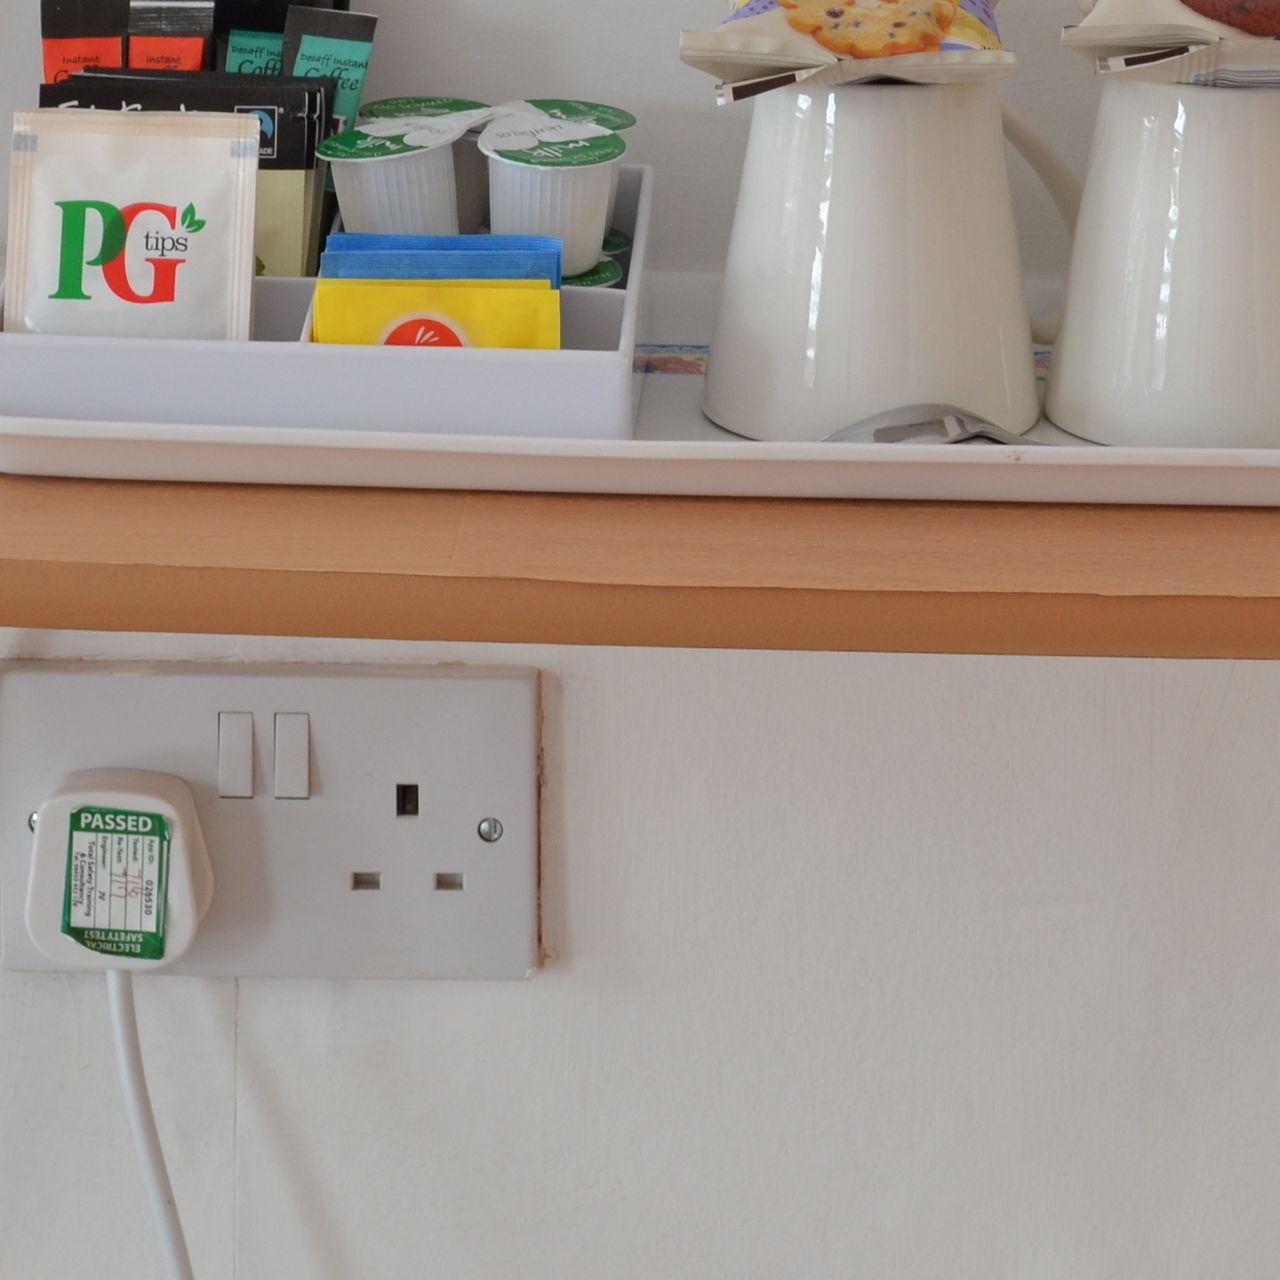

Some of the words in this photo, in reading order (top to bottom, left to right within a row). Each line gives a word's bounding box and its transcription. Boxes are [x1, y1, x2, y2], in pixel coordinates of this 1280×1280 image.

[62, 55, 101, 64] Instant
[146, 55, 182, 64] Instant
[238, 58, 283, 76] Coff
[333, 57, 369, 70] Instant
[305, 66, 360, 92] Cffee
[48, 200, 186, 304] PG
[144, 230, 189, 257] tips
[80, 812, 152, 832] PASSED
[87, 840, 95, 859] Total
[85, 861, 94, 885] Safety
[84, 886, 93, 918] Training
[84, 930, 106, 940] TEST
[108, 931, 144, 943] SAFETY
[85, 941, 141, 953] ELECTRICAL
